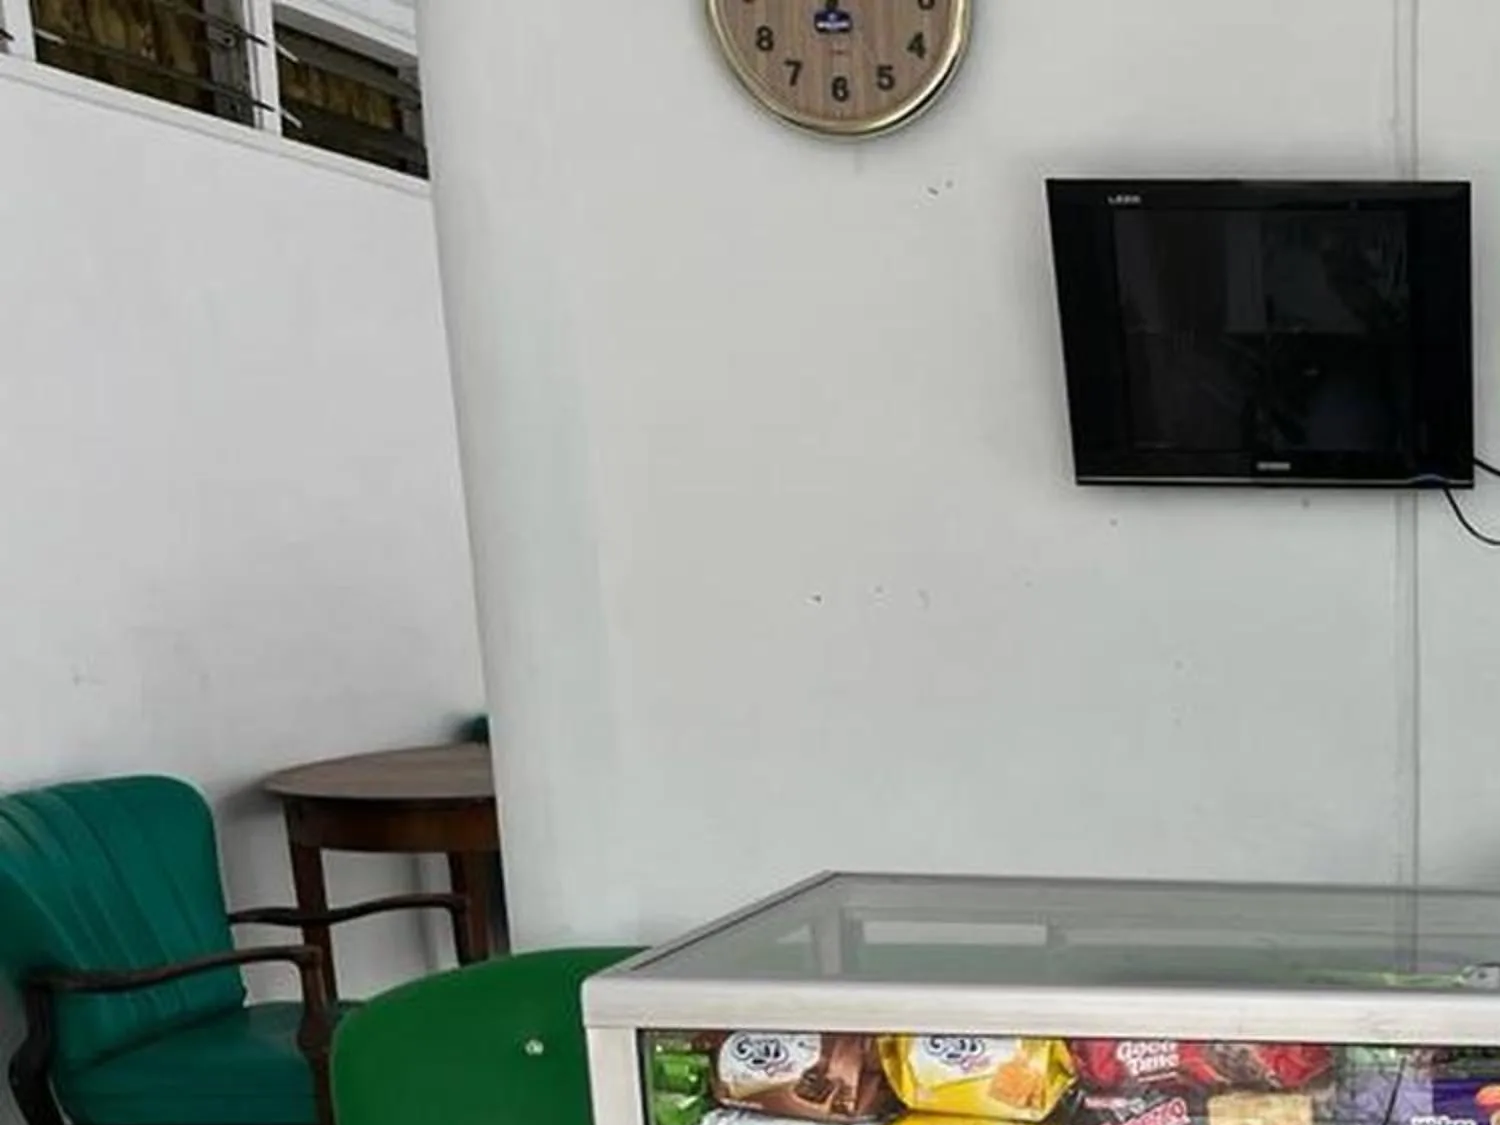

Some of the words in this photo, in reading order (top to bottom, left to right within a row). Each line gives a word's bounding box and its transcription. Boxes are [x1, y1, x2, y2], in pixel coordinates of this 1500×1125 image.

[755, 26, 774, 51] 8
[906, 32, 926, 58] 4
[784, 60, 803, 86] 7
[876, 65, 895, 90] 5
[831, 77, 849, 102] 6
